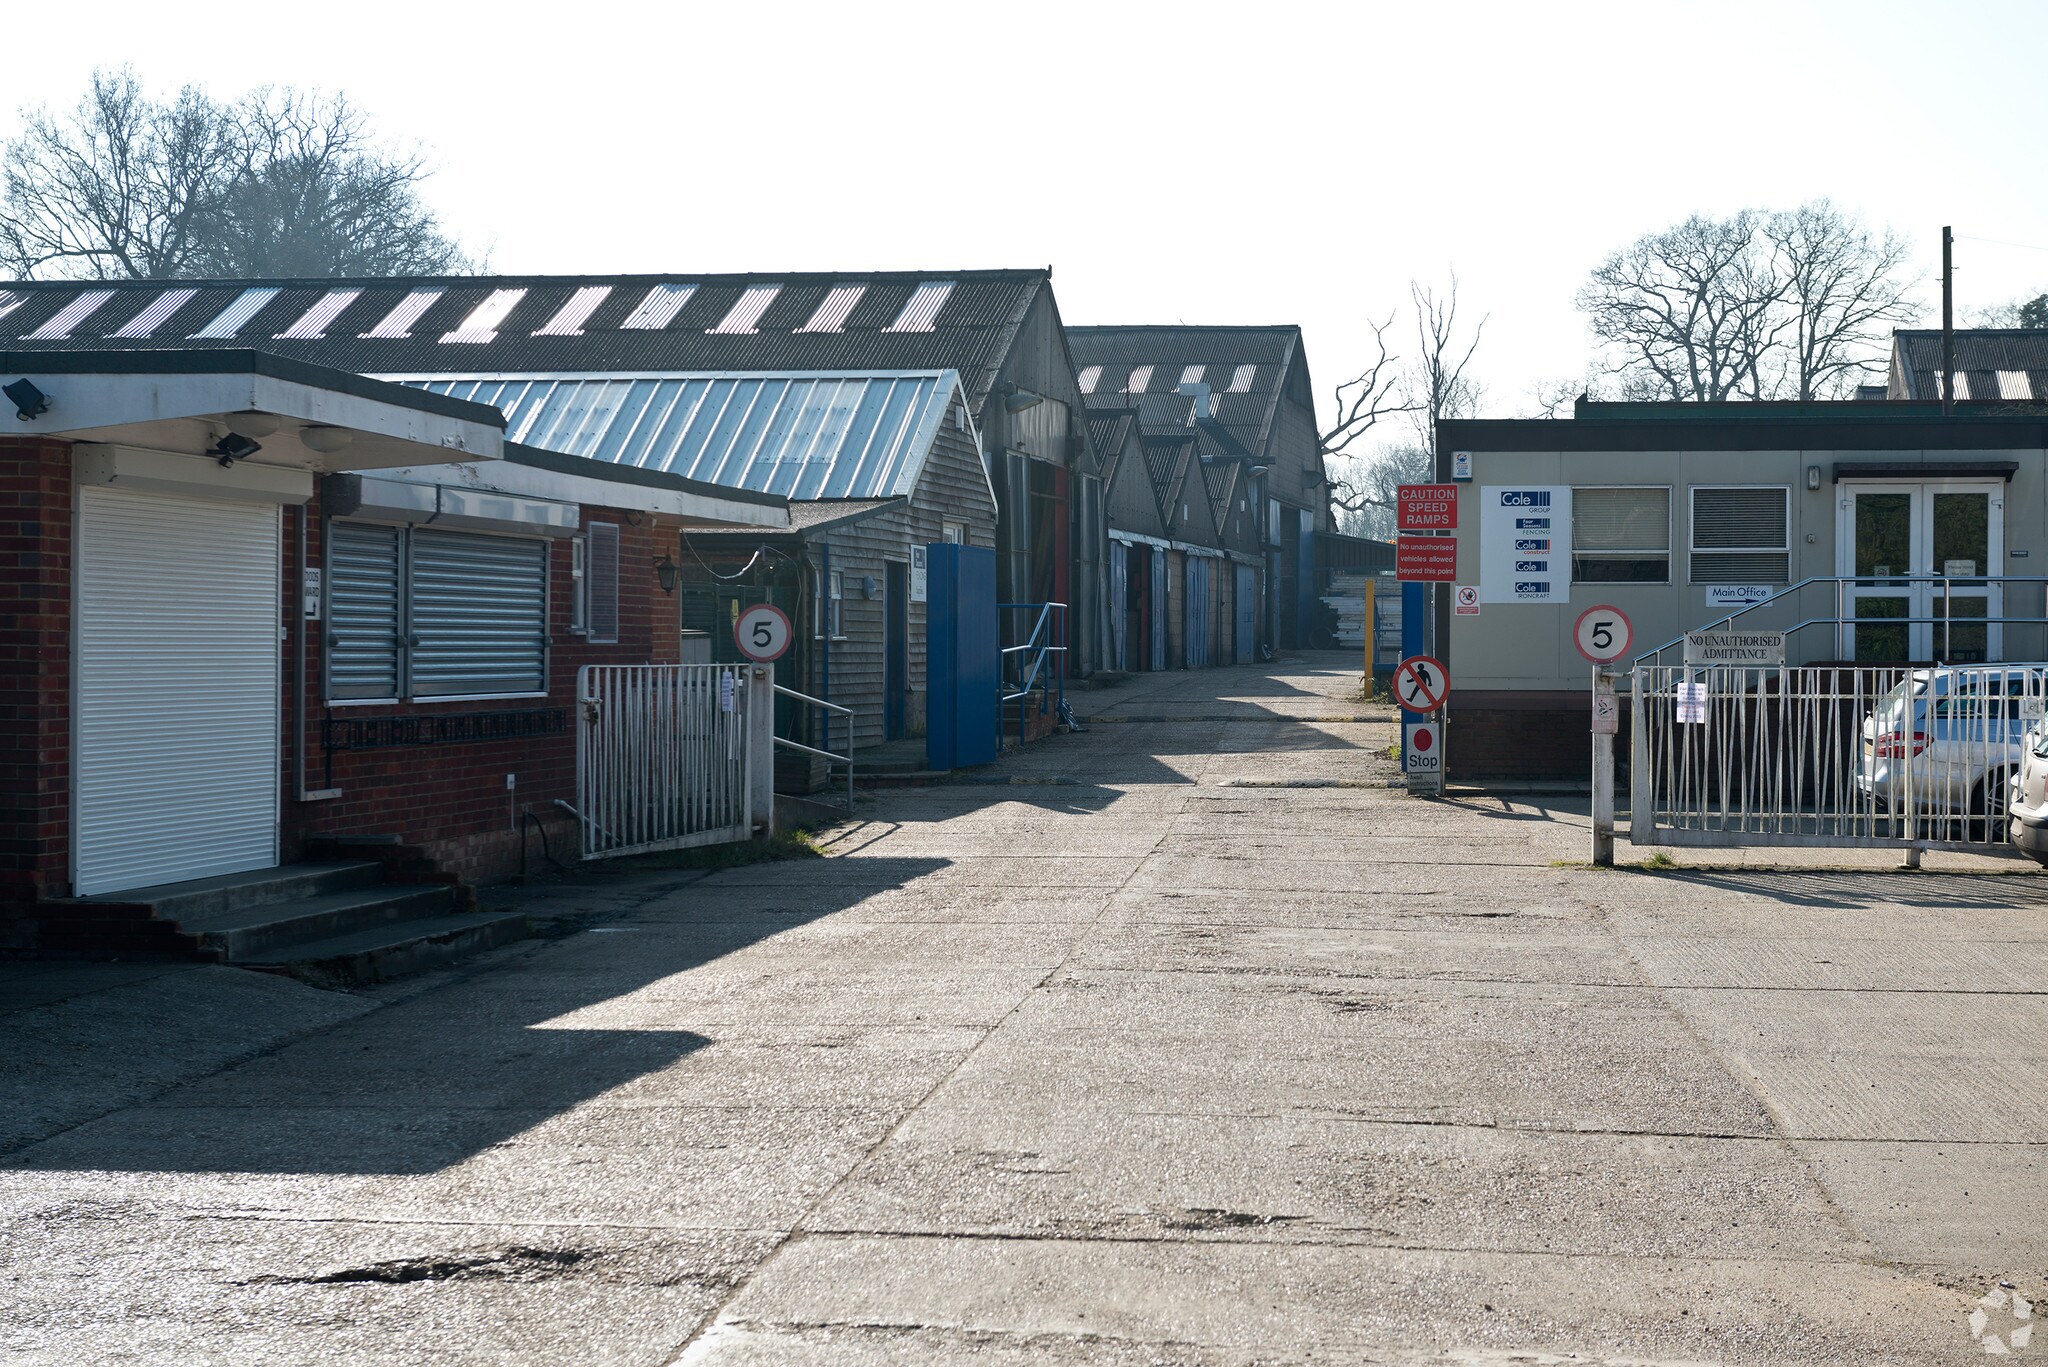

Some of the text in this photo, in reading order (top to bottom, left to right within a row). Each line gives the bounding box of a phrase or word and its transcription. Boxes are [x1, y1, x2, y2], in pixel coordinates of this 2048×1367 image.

[1400, 489, 1455, 499] CAUTION
[1502, 492, 1531, 506] Cole
[1408, 502, 1448, 512] SPEED
[1406, 514, 1449, 524] RAMPS
[1516, 540, 1536, 550] Cole
[1516, 561, 1536, 571] Cole
[1398, 567, 1422, 575] beyond
[1437, 568, 1454, 576] point
[1515, 582, 1536, 592] Cole
[1712, 586, 1767, 597] Main Office
[752, 621, 772, 648] 5
[1592, 622, 1613, 649] 5
[1689, 636, 1781, 647] NO UNAUTHORISED
[1702, 648, 1768, 660] ADMITTANCE
[1409, 754, 1438, 769] Stop
